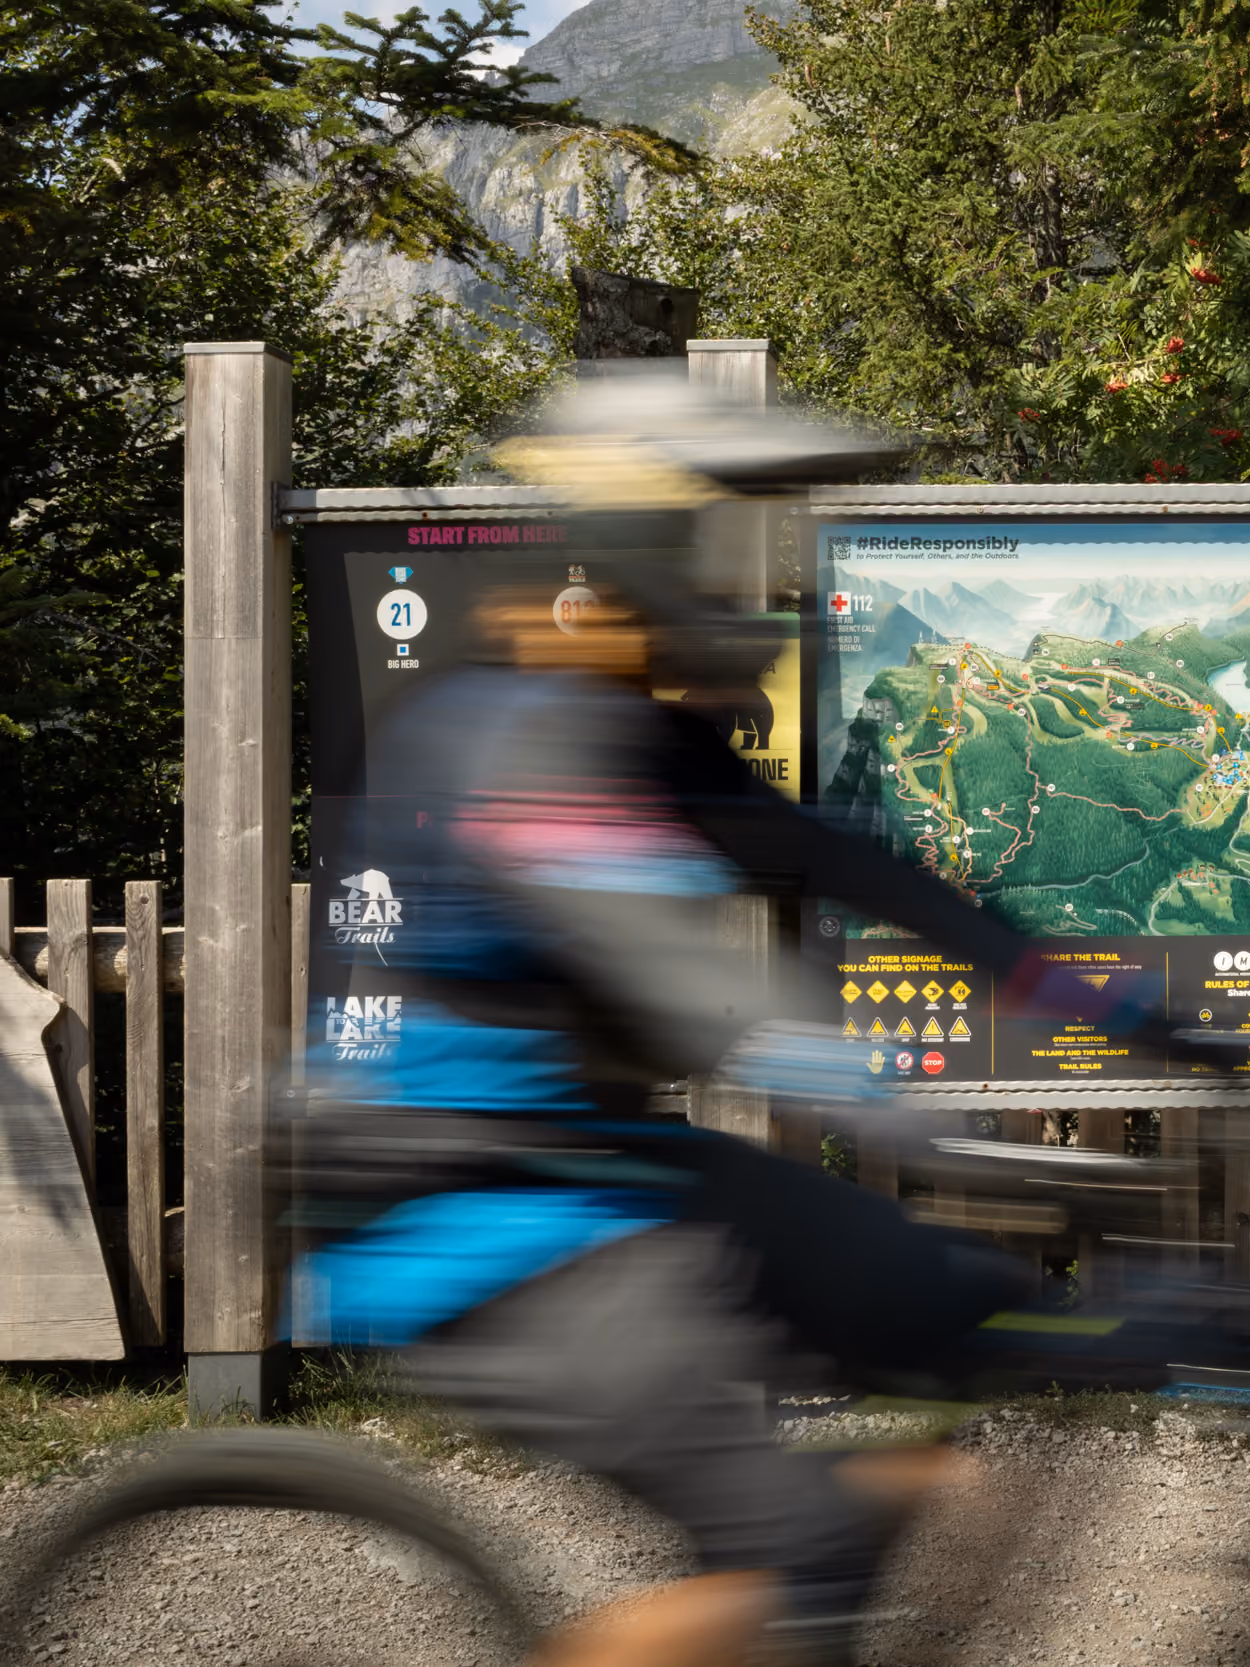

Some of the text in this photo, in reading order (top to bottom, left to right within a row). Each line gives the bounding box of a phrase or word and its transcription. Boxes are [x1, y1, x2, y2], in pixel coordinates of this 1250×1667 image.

[408, 526, 465, 544] START
[468, 525, 519, 544] FROM
[857, 536, 1019, 552] #RideResponsibly
[853, 594, 873, 612] 112
[391, 603, 411, 626] 21
[862, 625, 876, 633] CALL
[388, 660, 419, 669] BIG HERO
[743, 758, 789, 780] ONE
[329, 900, 403, 924] BEAR
[334, 926, 396, 944] Trails
[901, 955, 942, 963] SIGNAGE
[1093, 953, 1120, 961] TRAIL
[837, 964, 857, 972] YOU
[859, 964, 878, 972] CAN
[881, 964, 903, 972] FIND
[904, 964, 919, 972] ON
[921, 964, 939, 972] THE
[1205, 981, 1234, 989] RULES
[1236, 980, 1249, 988] OF
[326, 996, 402, 1018] LAKE
